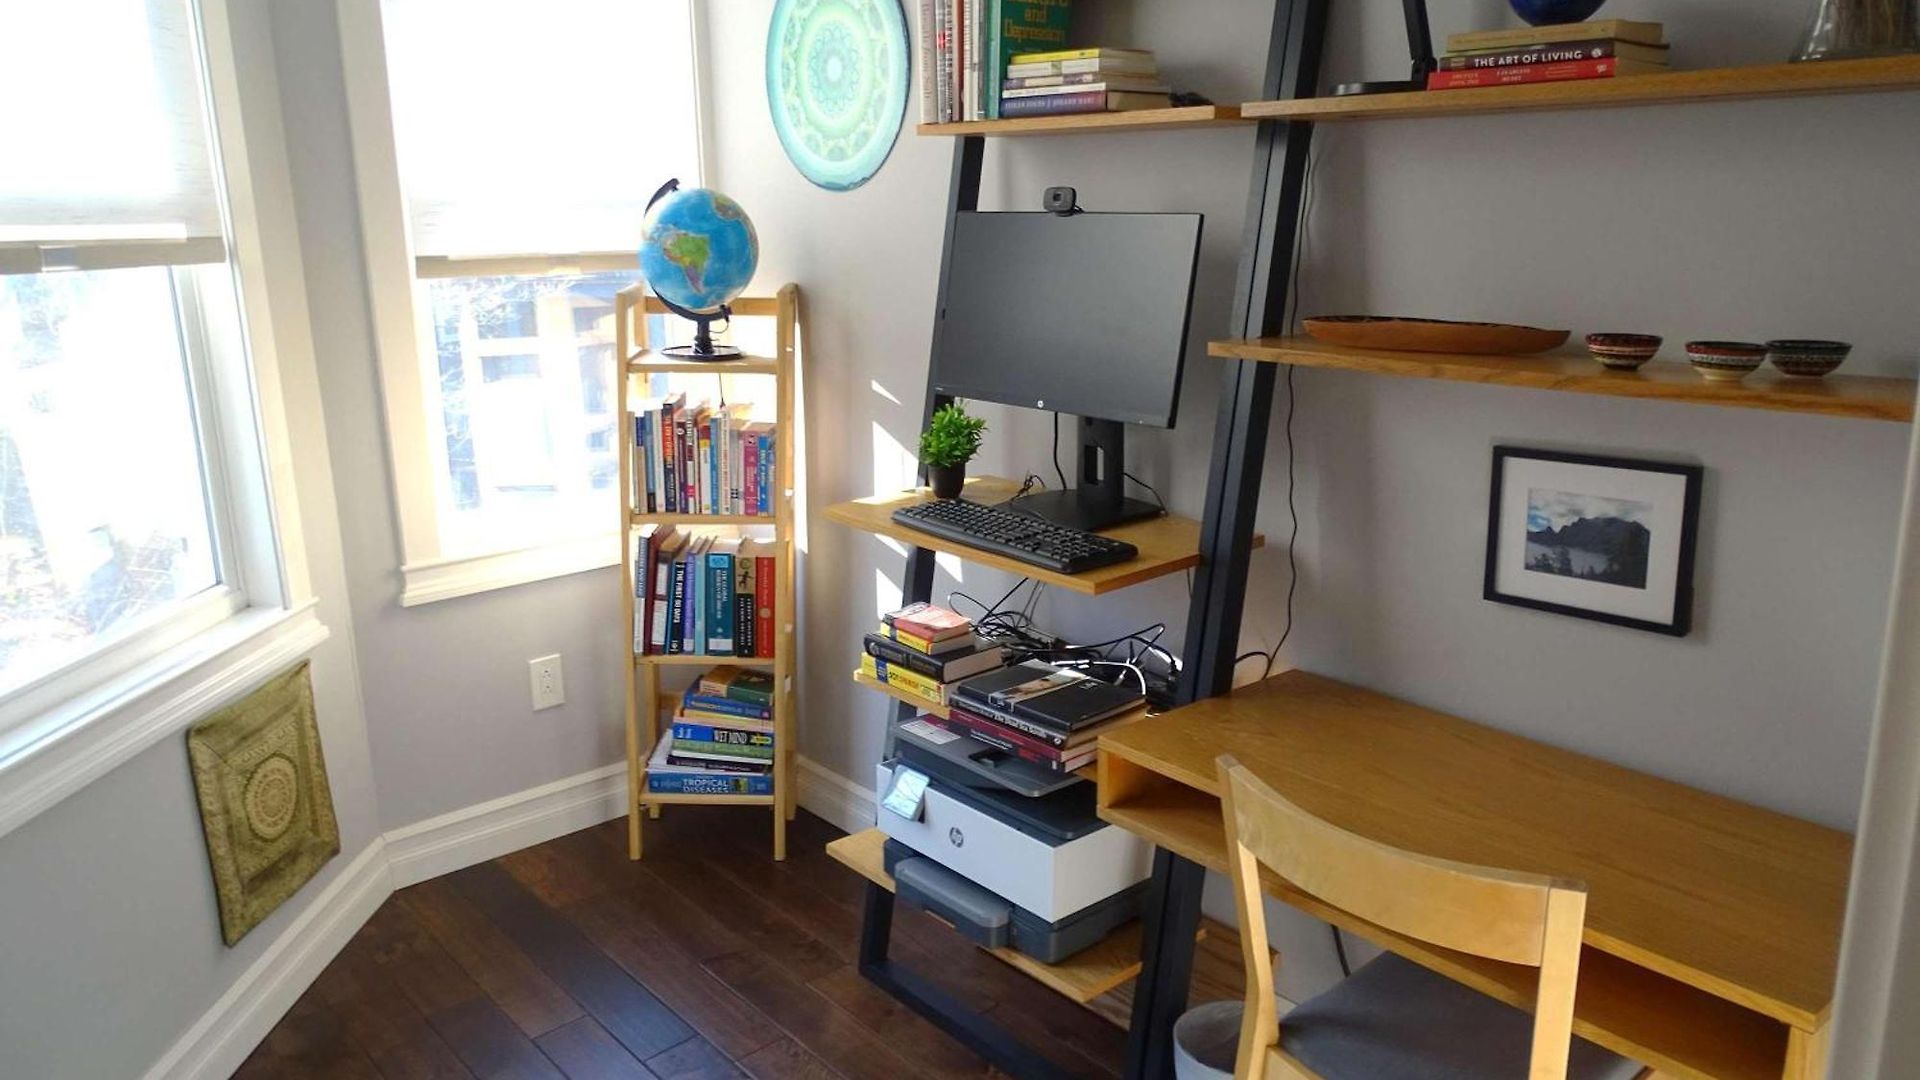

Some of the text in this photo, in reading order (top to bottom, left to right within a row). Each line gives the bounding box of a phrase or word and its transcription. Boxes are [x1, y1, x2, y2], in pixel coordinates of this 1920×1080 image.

[1024, 5, 1047, 22] and
[1004, 18, 1065, 43] Depression
[1474, 57, 1496, 68] THE
[1498, 55, 1519, 66] ART
[1522, 53, 1538, 64] OF
[1542, 50, 1583, 62] LIVING
[675, 582, 683, 598] FIRST
[673, 608, 681, 623] DAYS
[713, 730, 747, 744] WET MIND
[682, 779, 729, 787] TROPICAL
